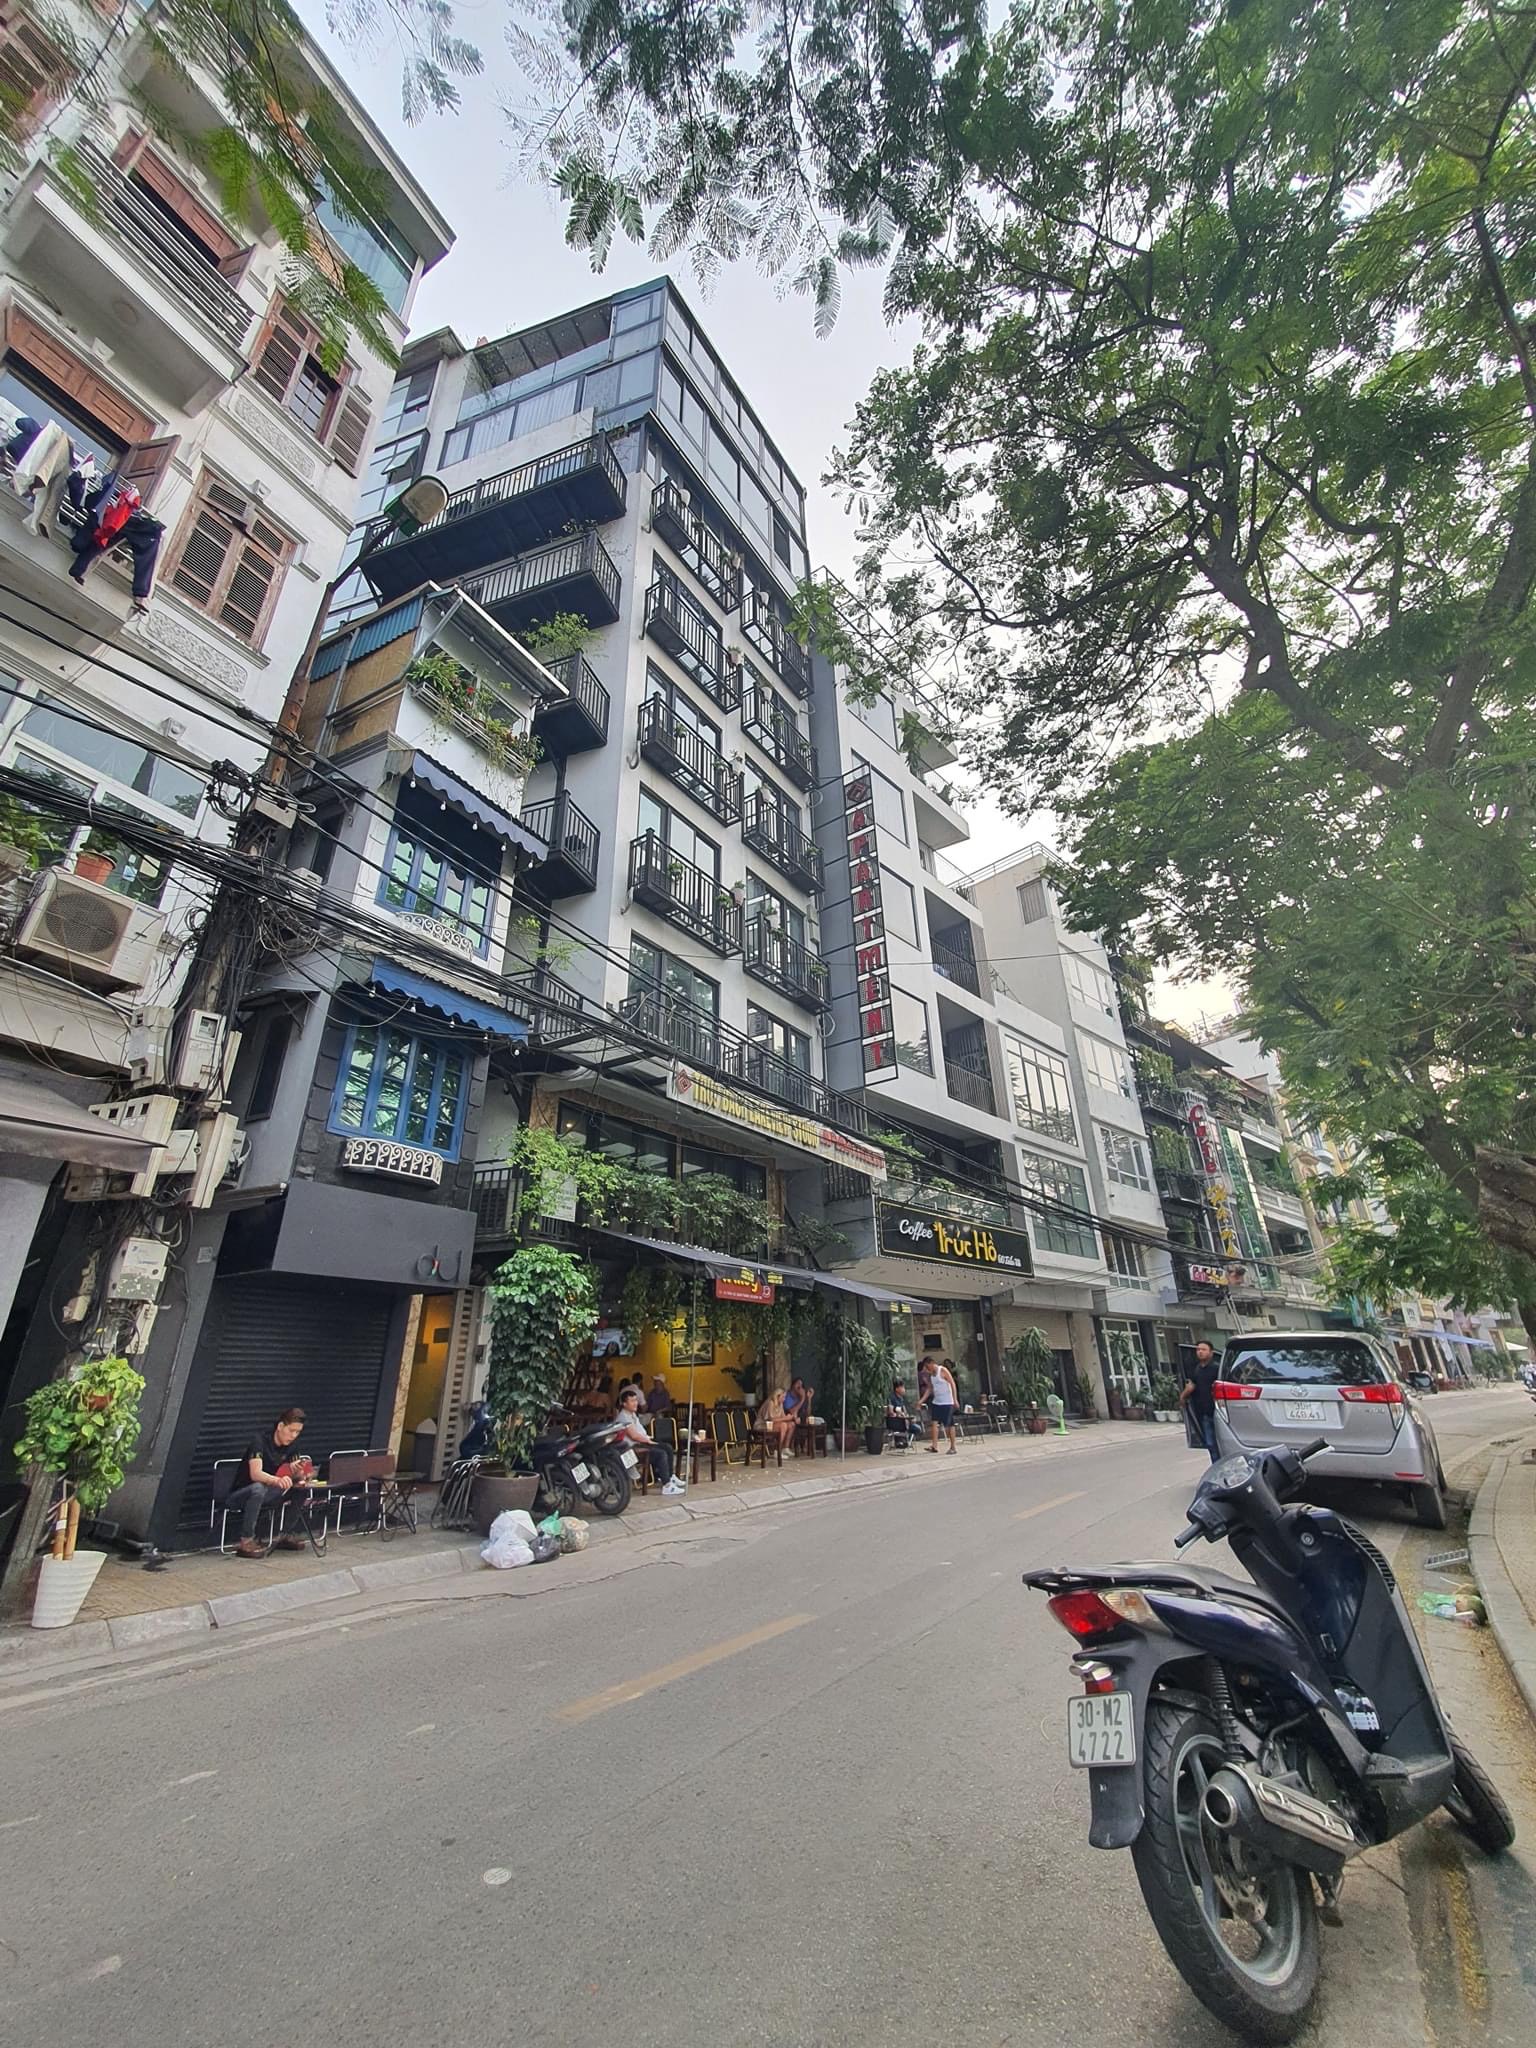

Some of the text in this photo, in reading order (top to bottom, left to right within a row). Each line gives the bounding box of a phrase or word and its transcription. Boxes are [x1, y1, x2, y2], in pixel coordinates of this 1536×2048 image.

[899, 1219, 933, 1241] Coffee
[933, 1221, 998, 1262] Trúc Hồ
[1078, 1730, 1125, 1762] 4722
